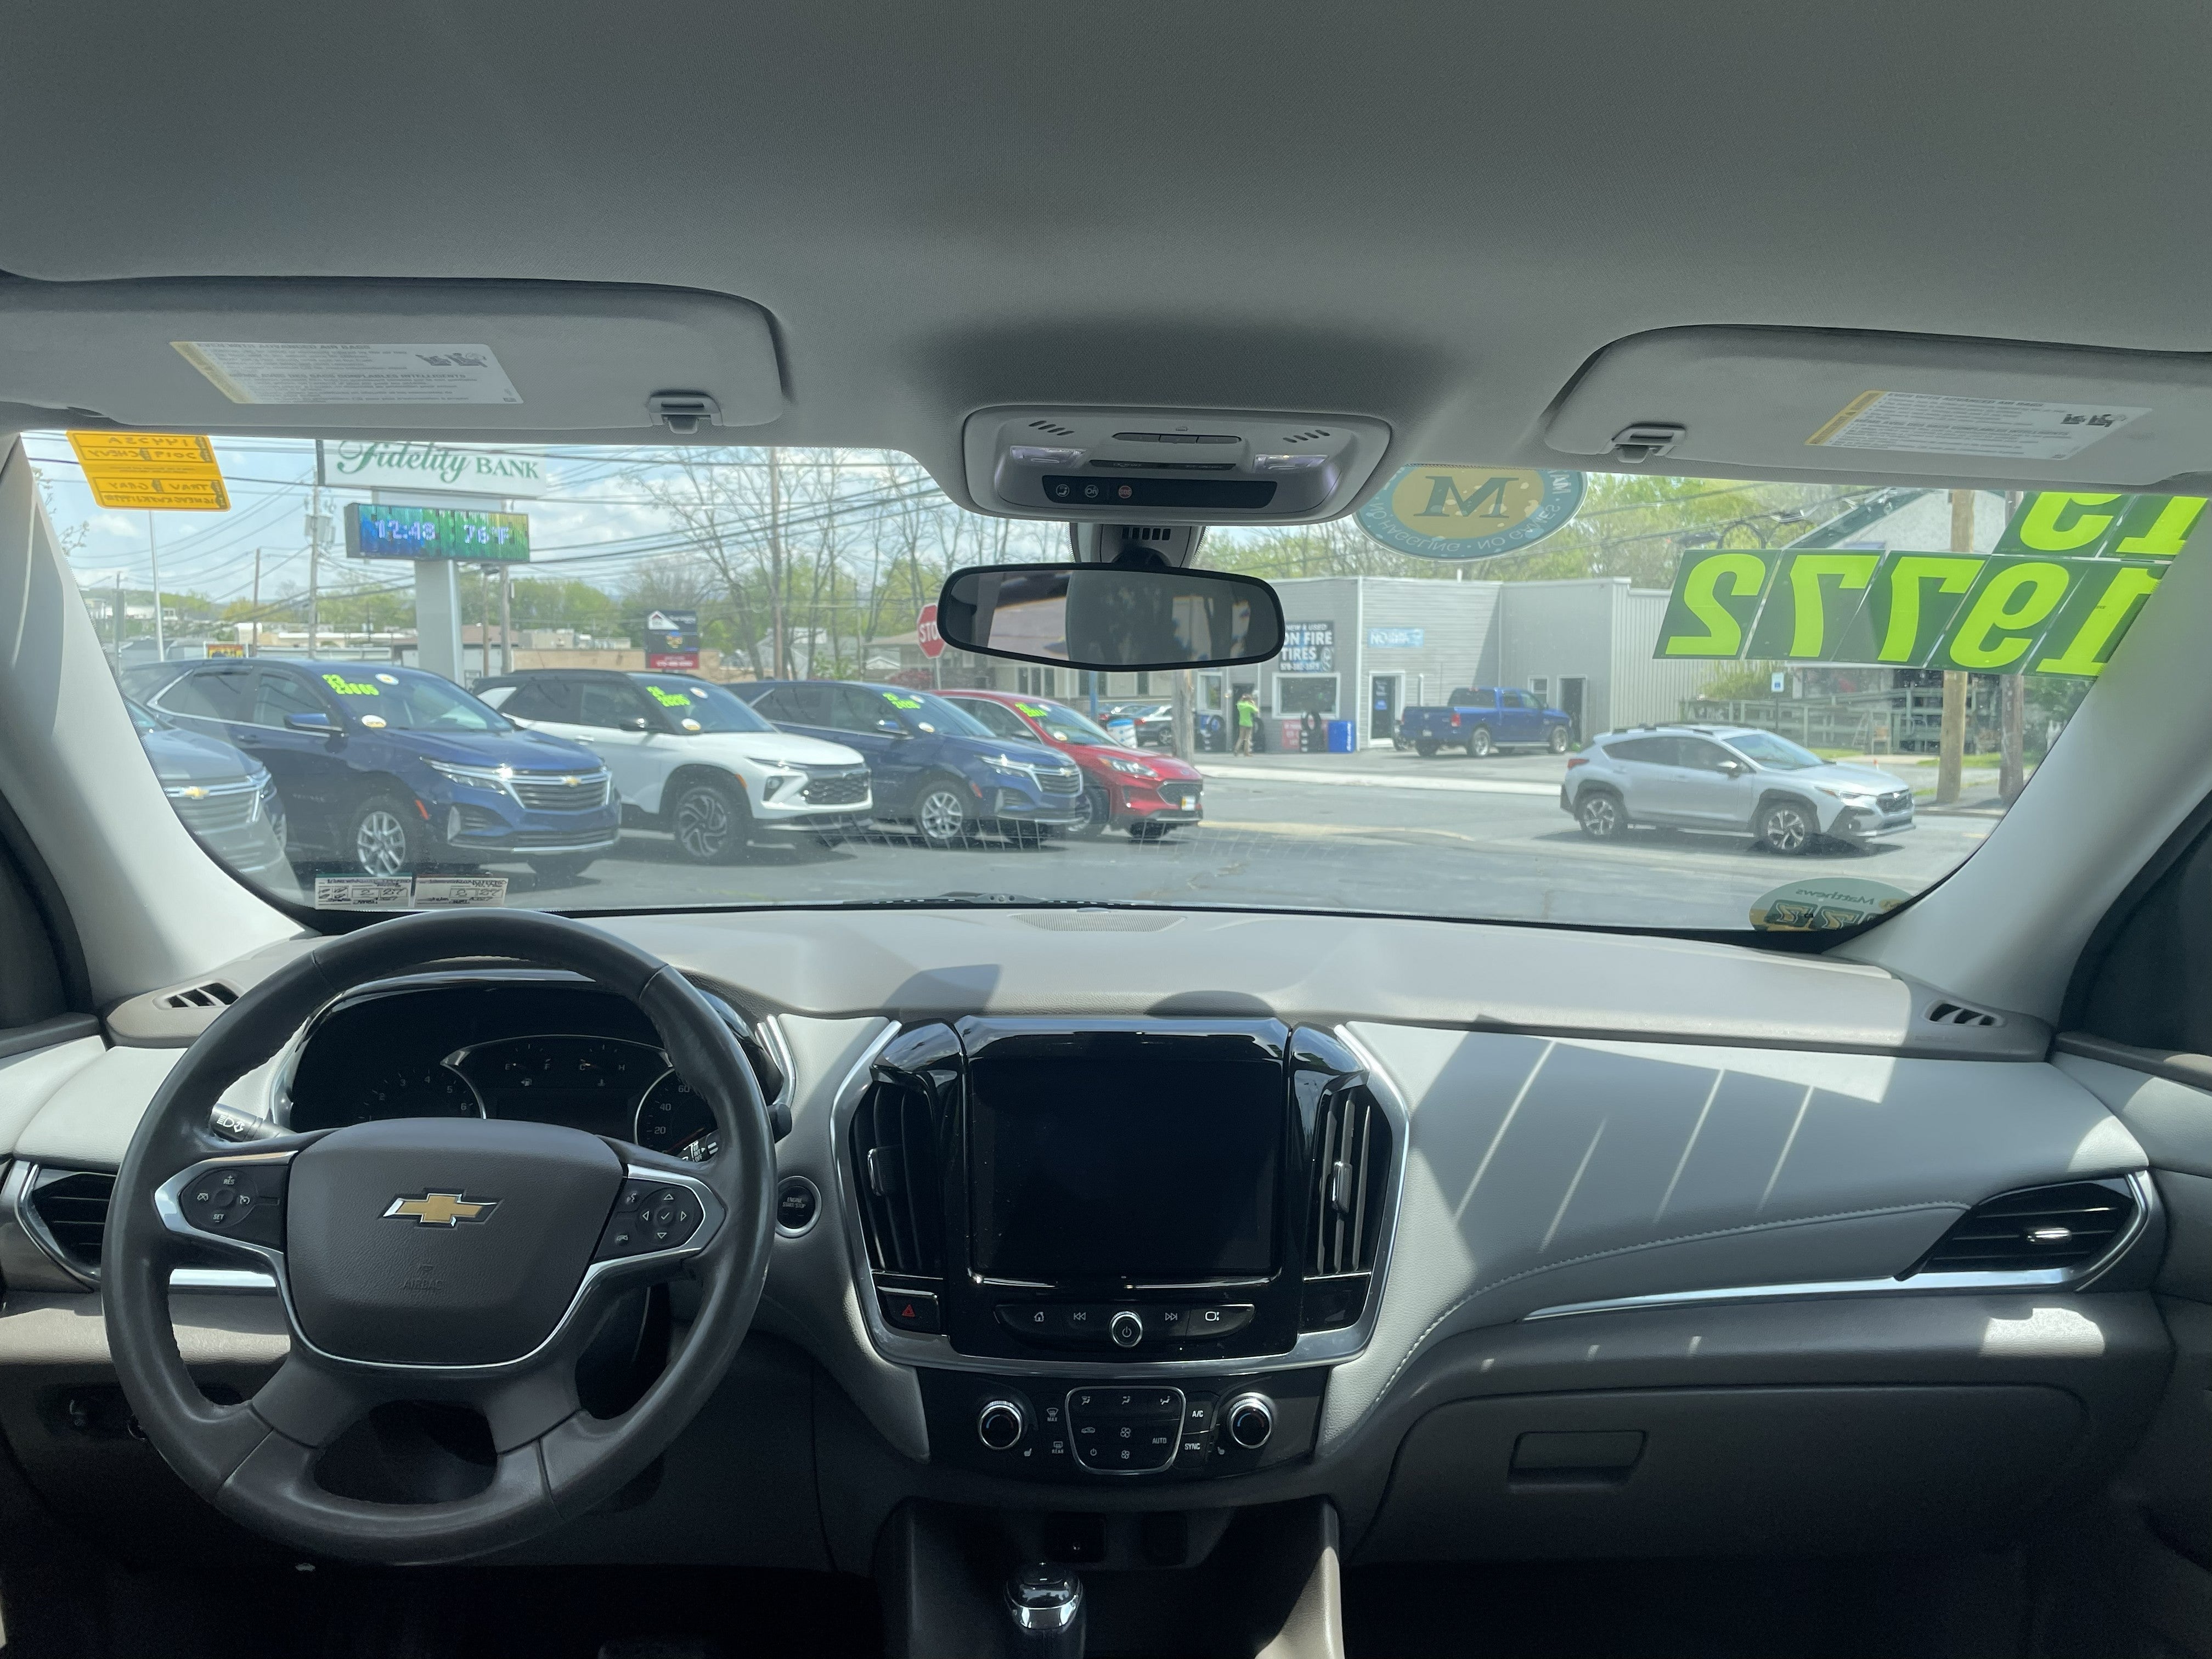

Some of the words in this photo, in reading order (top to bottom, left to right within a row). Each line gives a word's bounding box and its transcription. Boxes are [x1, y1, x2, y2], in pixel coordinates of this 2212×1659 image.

[337, 441, 471, 484] Fidelity
[476, 456, 539, 479] BANK
[1304, 631, 1333, 646] FIRE
[1281, 646, 1316, 661] TIRES
[654, 1126, 666, 1135] 20
